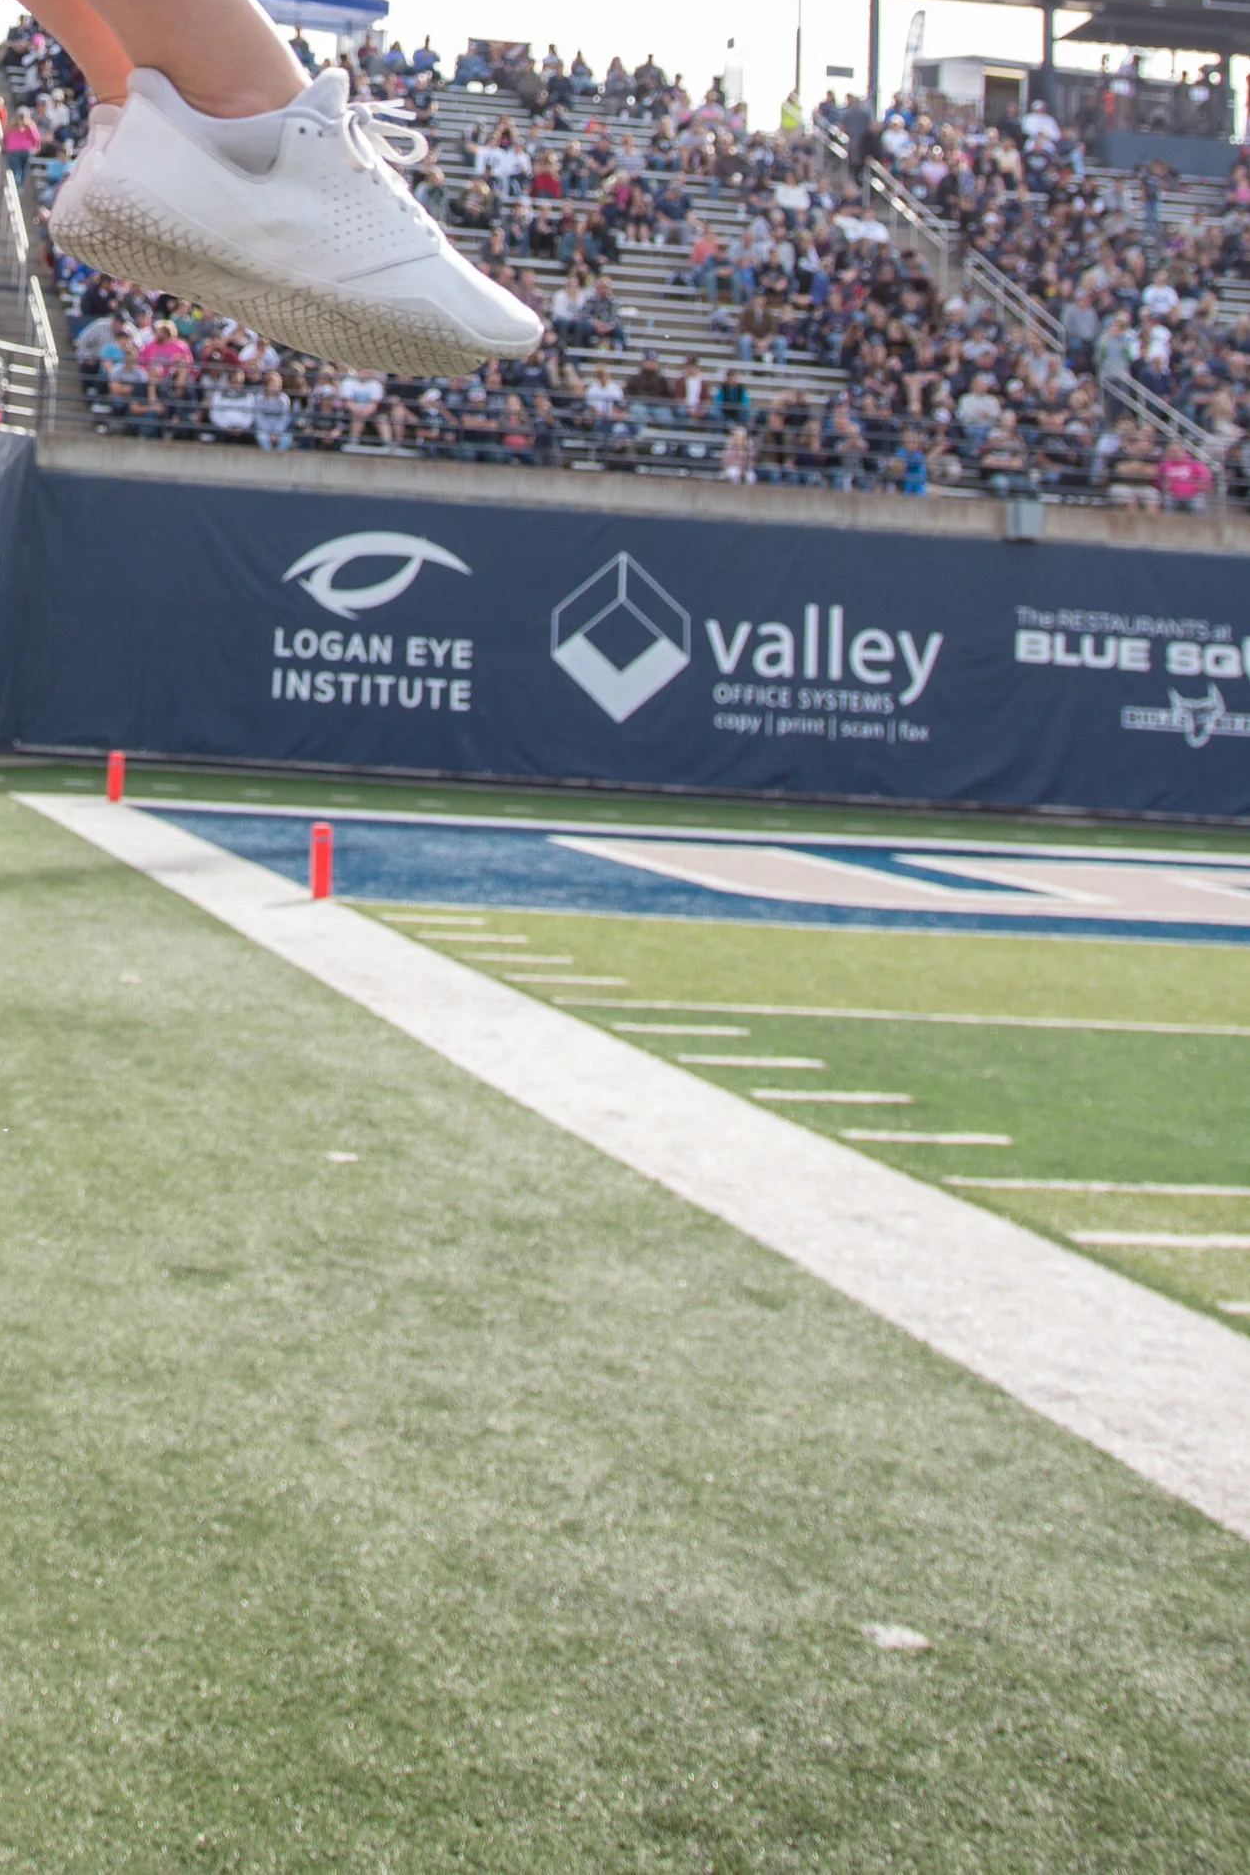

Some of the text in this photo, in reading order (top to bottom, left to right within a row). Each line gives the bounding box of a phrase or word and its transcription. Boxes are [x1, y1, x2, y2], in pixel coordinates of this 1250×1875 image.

[273, 627, 474, 670] LOGAN EYE
[704, 602, 944, 706] valley
[1014, 628, 1250, 681] BLUE SQ
[271, 668, 472, 712] INSTITUTE
[712, 681, 895, 715] OFFICE SYSTEMS
